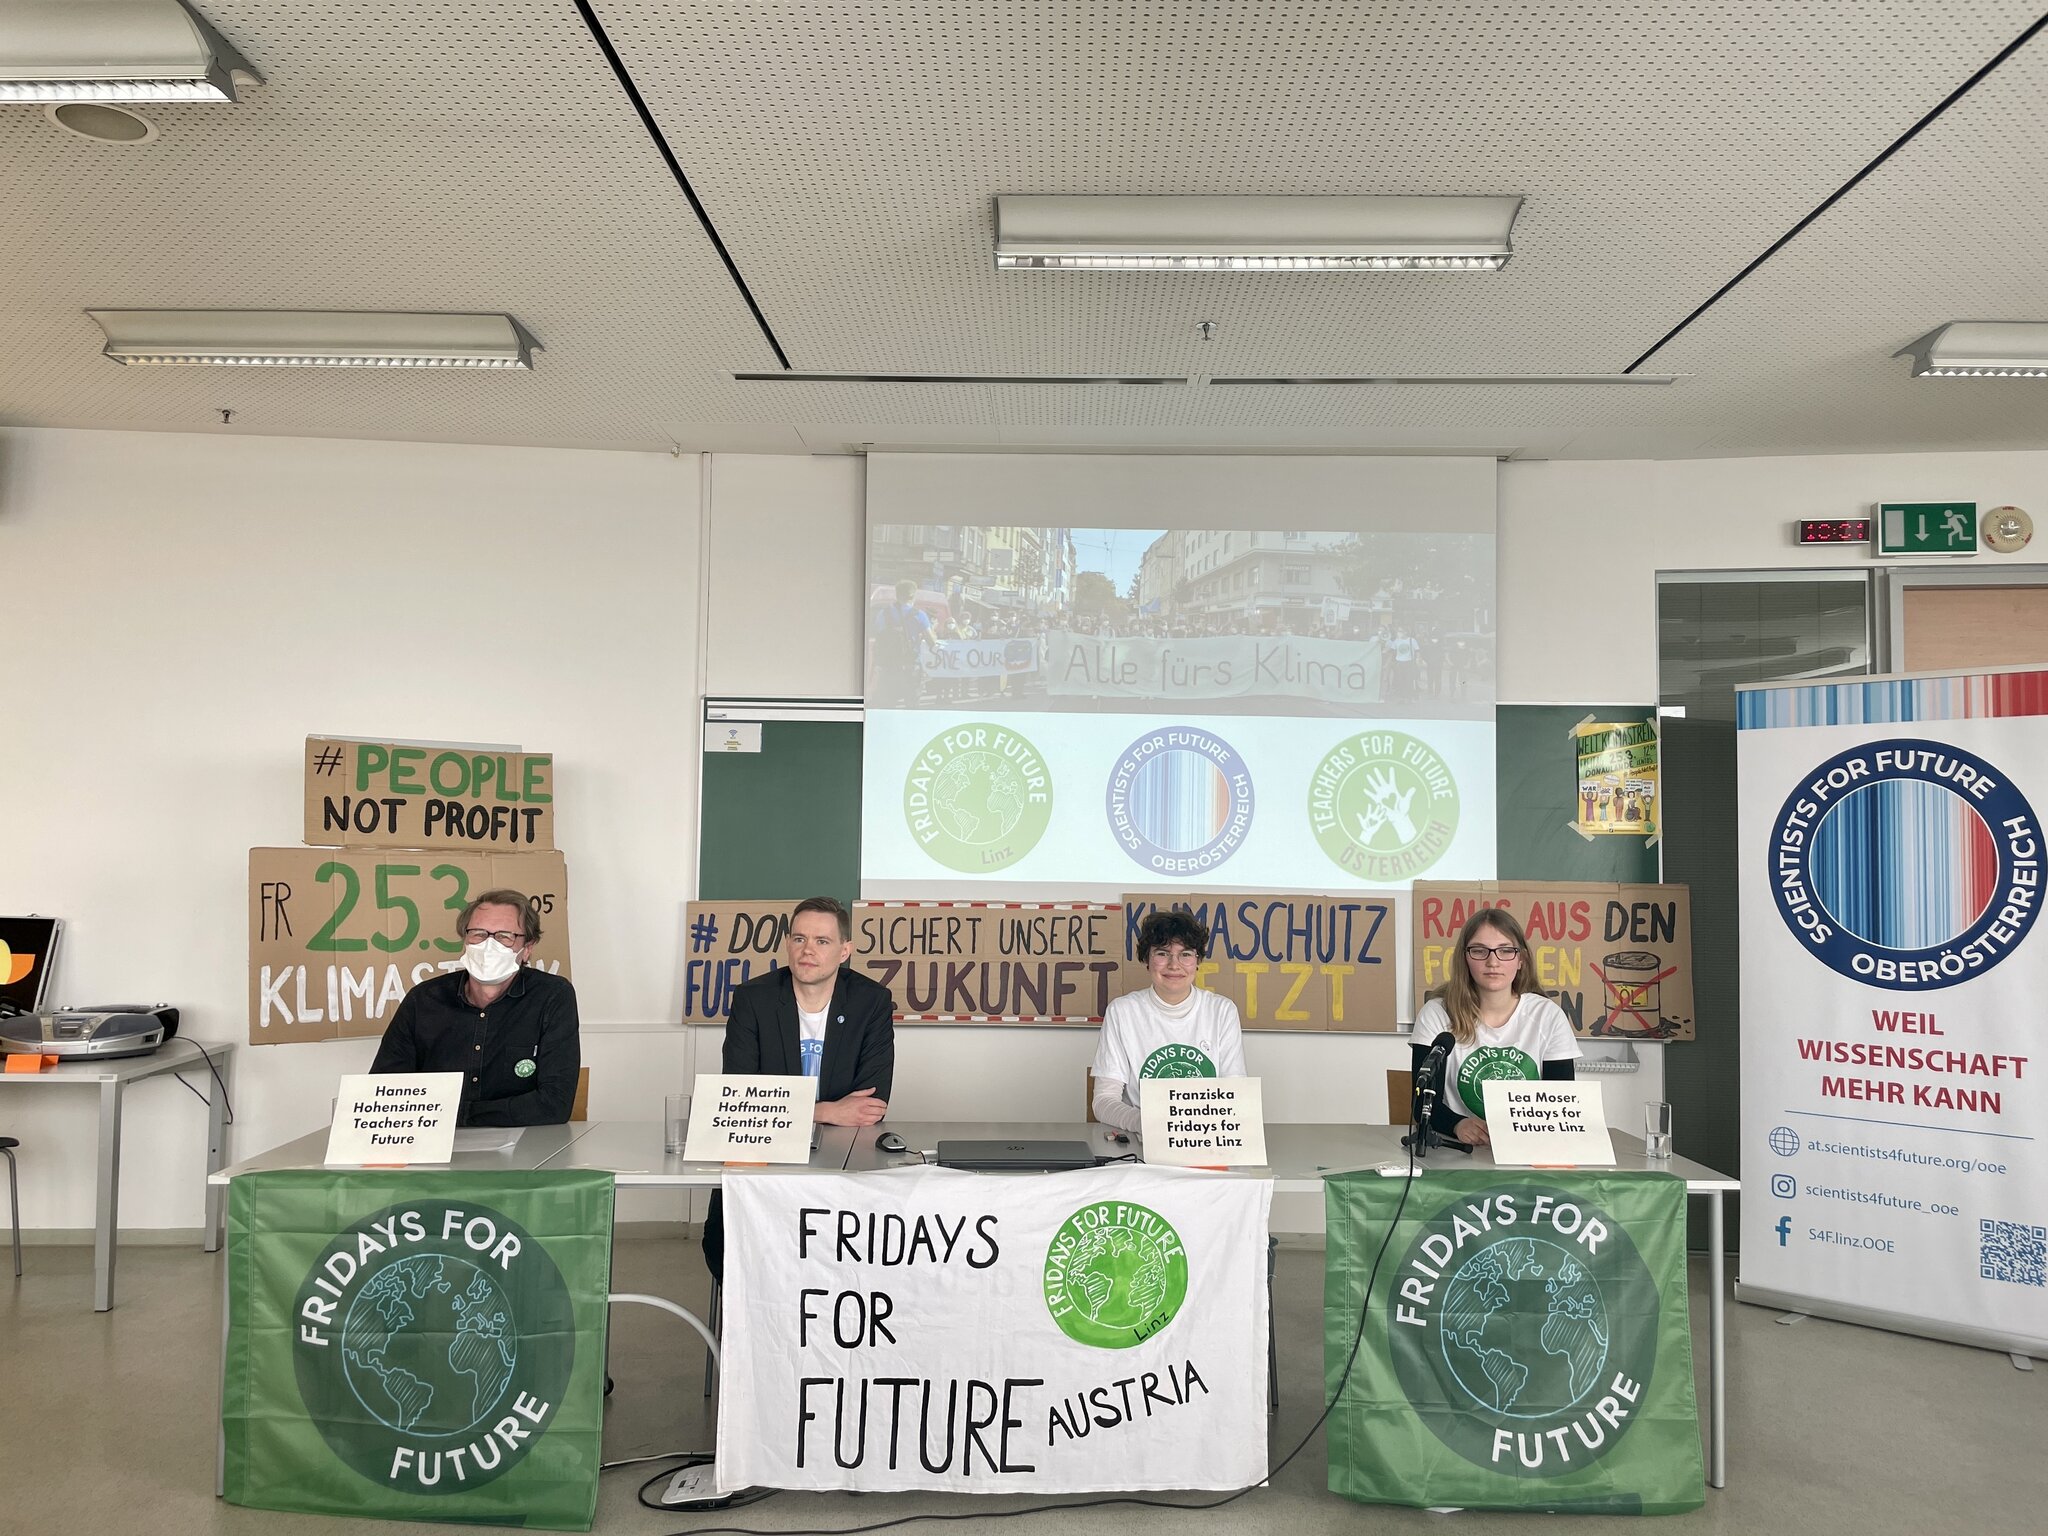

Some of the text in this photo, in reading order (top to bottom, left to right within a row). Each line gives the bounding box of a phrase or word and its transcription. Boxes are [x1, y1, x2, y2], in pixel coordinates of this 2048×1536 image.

[967, 649, 1003, 668] OUR
[1064, 643, 1366, 691] Alle fürs Klima
[314, 745, 552, 803] # PEOPLE
[909, 728, 1047, 843] FRIDAYS FOR FUTURE
[1112, 732, 1231, 850] SCIENTISTS FOR FUTURE
[1312, 735, 1453, 834] TEACHERS FOR FUTURE
[323, 796, 543, 843] NOT PROFIT
[1151, 773, 1250, 871] OBERÖSTERREICH
[981, 846, 1014, 865] Linz
[1339, 820, 1450, 876] ÖSTERREICH
[1779, 750, 1997, 944] SCIENTISTS FOR FUTURE
[261, 882, 292, 942] FR
[1851, 815, 2039, 983] OBERÖSTERREICH
[856, 915, 1107, 955] SICHERT UNSERE
[1125, 902, 1387, 964] KASCHUTZ
[1423, 898, 1676, 943] RA AUS DEN
[867, 960, 1119, 1017] ZUKUNFT
[1195, 962, 1354, 1021] ETZT
[1620, 986, 1641, 1005] ÖL
[1872, 1010, 1944, 1036] WEIL
[1142, 1047, 1204, 1079] RIDAYS FOR
[1460, 1048, 1524, 1084] FRIDAYS FOR
[1797, 1039, 2028, 1079] WISSENSCHAFT
[353, 1100, 442, 1112] Hohensinner,
[375, 1086, 427, 1097] Hannes
[718, 1101, 790, 1114] Hoffmann,
[722, 1086, 790, 1098] Dr. Martin
[1169, 1088, 1235, 1101] Franziska
[1508, 1092, 1580, 1104] Lea Moser,
[1821, 1076, 2001, 1114] MEHR KANN
[353, 1116, 438, 1129] Teachers for
[712, 1116, 793, 1129] Scientist for
[1167, 1120, 1241, 1135] Fridays for
[1169, 1104, 1236, 1117] Brandner,
[1509, 1106, 1582, 1121] Fridays for
[1512, 1122, 1586, 1133] Future Linz
[371, 1133, 415, 1145] Future
[728, 1132, 772, 1144] Future
[1168, 1135, 1242, 1148] Future Linz
[1807, 1139, 2007, 1175] at.scientists4future.org/ooe
[1805, 1184, 1959, 1217] scientists4future_ooe
[799, 1208, 999, 1269] FRIDAYS
[1808, 1228, 1895, 1253] S4F.linz.OOE
[1046, 1205, 1185, 1318] FRIDAYS FOR FUTURE
[800, 1289, 897, 1349] FOR
[1133, 1312, 1169, 1342] Linz
[1396, 1194, 1641, 1468] FRIDAYS FOR FUTURE
[301, 1210, 550, 1485] FRIDAYS FOR FUTURE
[796, 1359, 1209, 1476] FUTURE AUSTRIA
